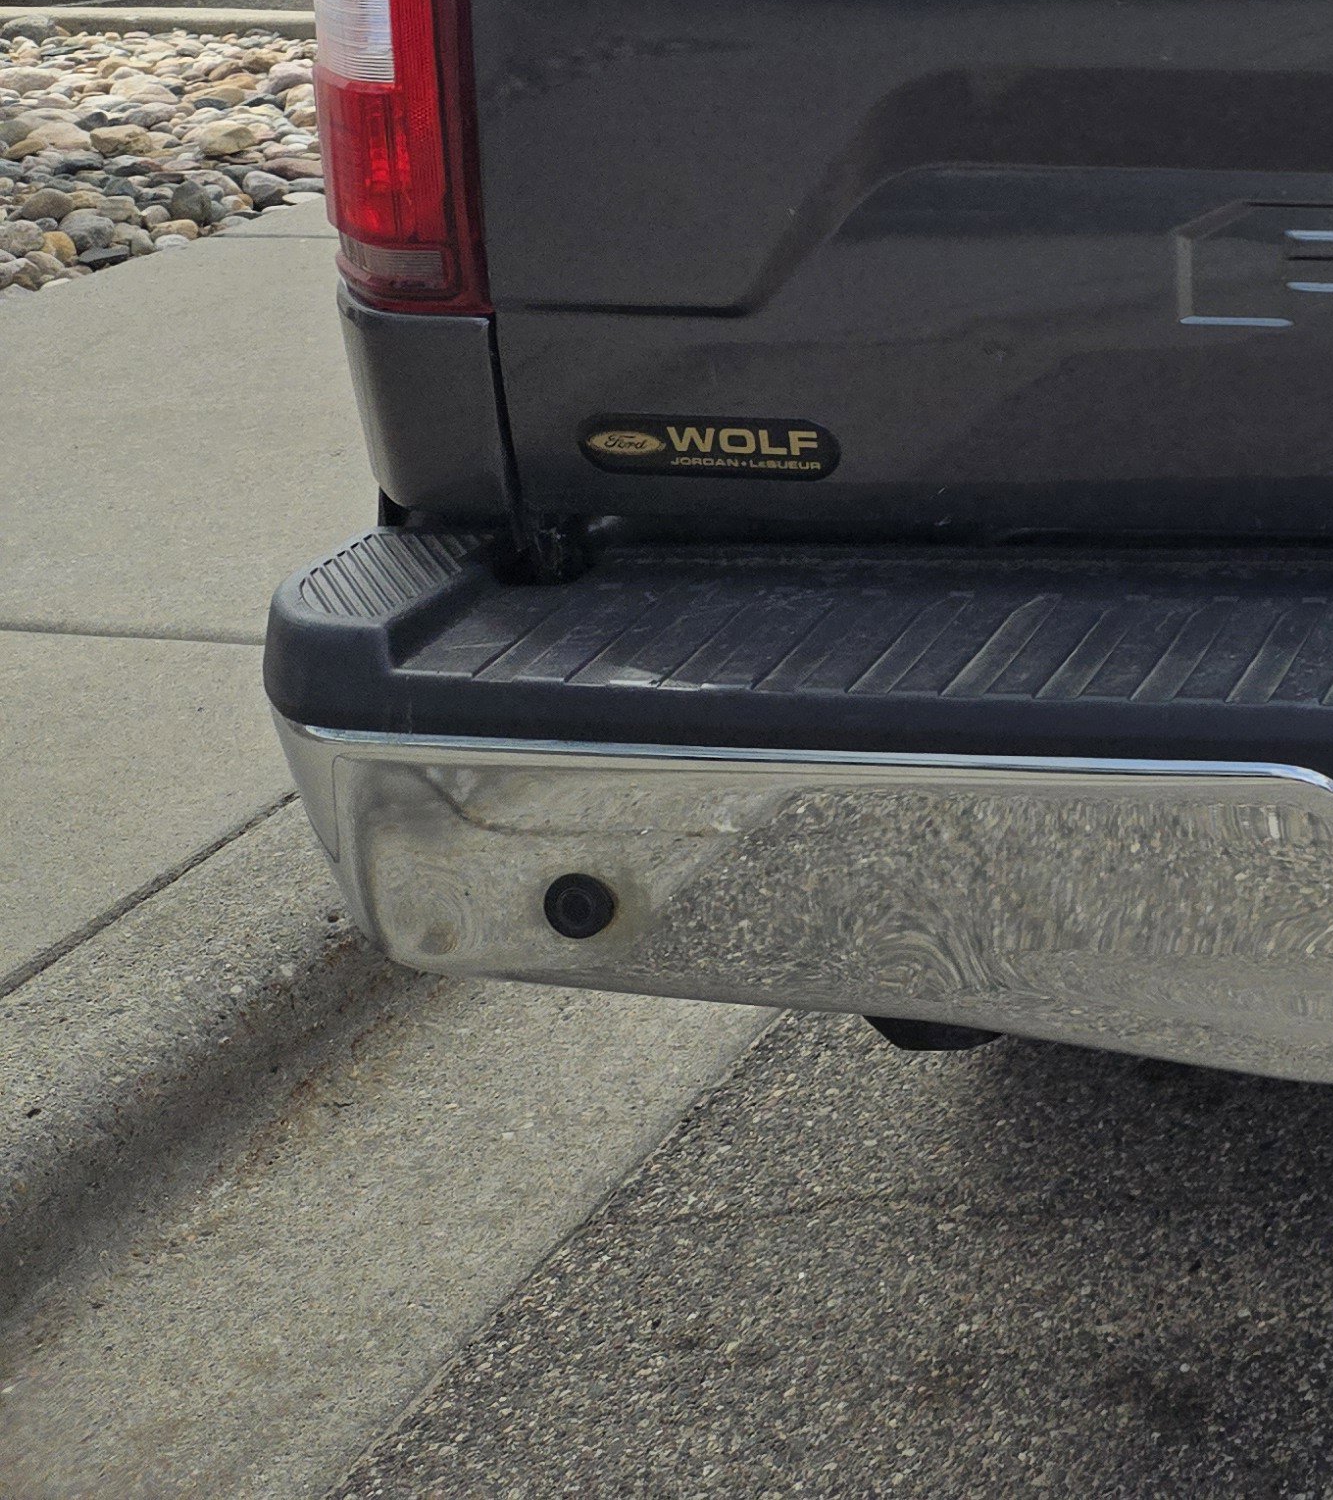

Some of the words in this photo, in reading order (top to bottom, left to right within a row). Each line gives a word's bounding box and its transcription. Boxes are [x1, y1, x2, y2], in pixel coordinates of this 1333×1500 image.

[604, 434, 647, 450] Ford
[666, 426, 819, 456] WOLF
[670, 456, 740, 468] JORDAN
